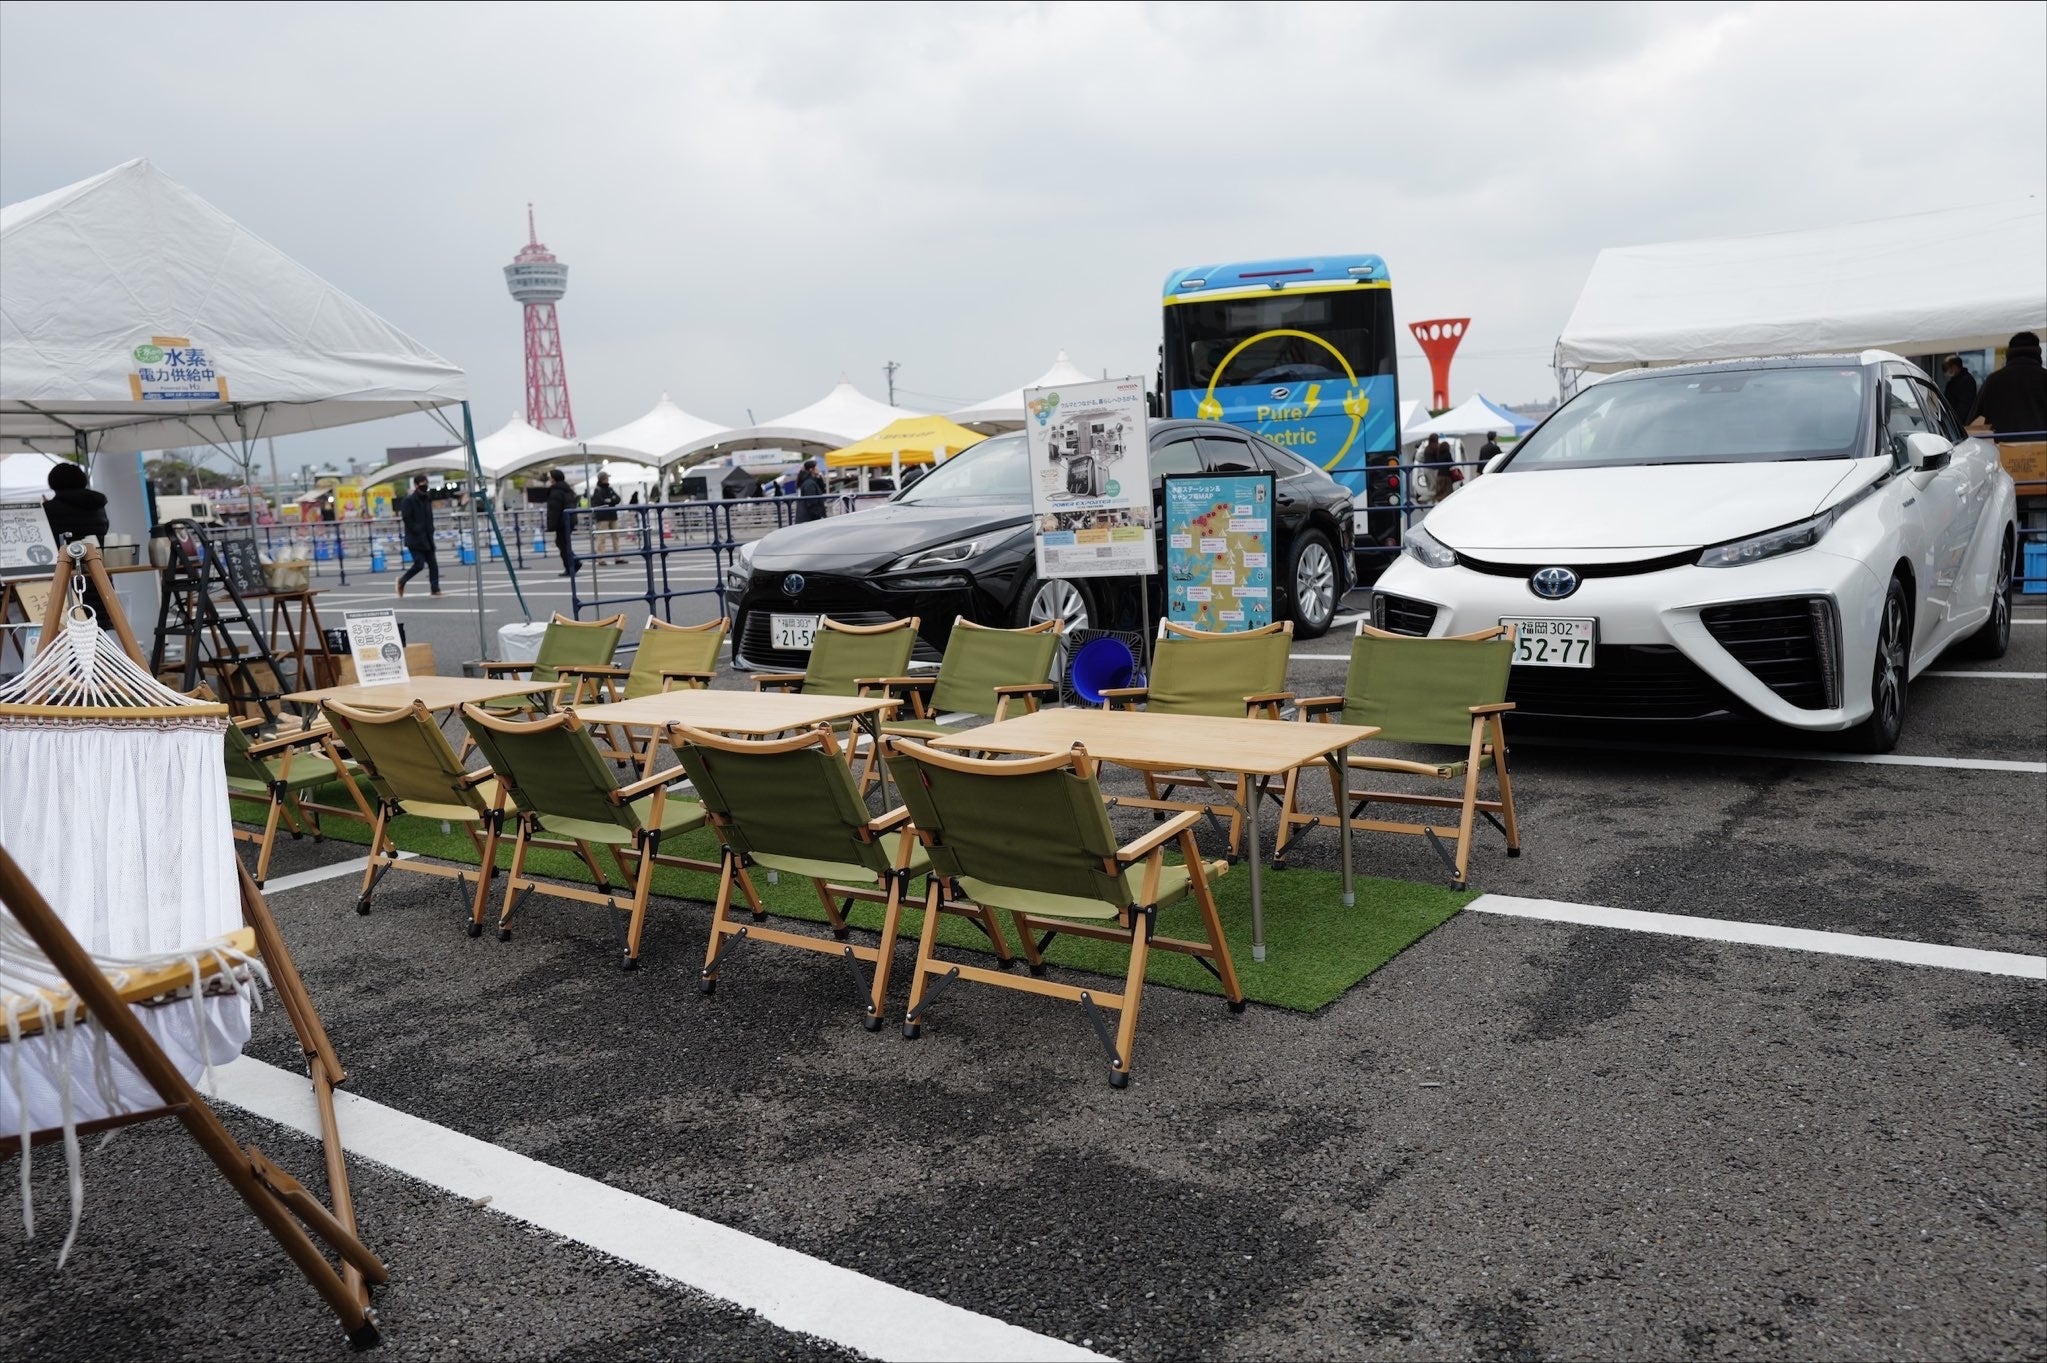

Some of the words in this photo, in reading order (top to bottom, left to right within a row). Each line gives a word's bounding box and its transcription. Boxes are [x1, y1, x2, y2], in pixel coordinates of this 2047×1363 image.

[165, 348, 214, 366] 水素で
[139, 368, 215, 382] 電力供給中
[1256, 405, 1303, 424] Pure
[352, 622, 393, 635] キャンプ
[796, 619, 809, 628] 303
[1521, 621, 1548, 635] 福岡
[1549, 622, 1573, 636] 302
[354, 634, 395, 646] セミナー
[1520, 637, 1590, 664] 52-77
